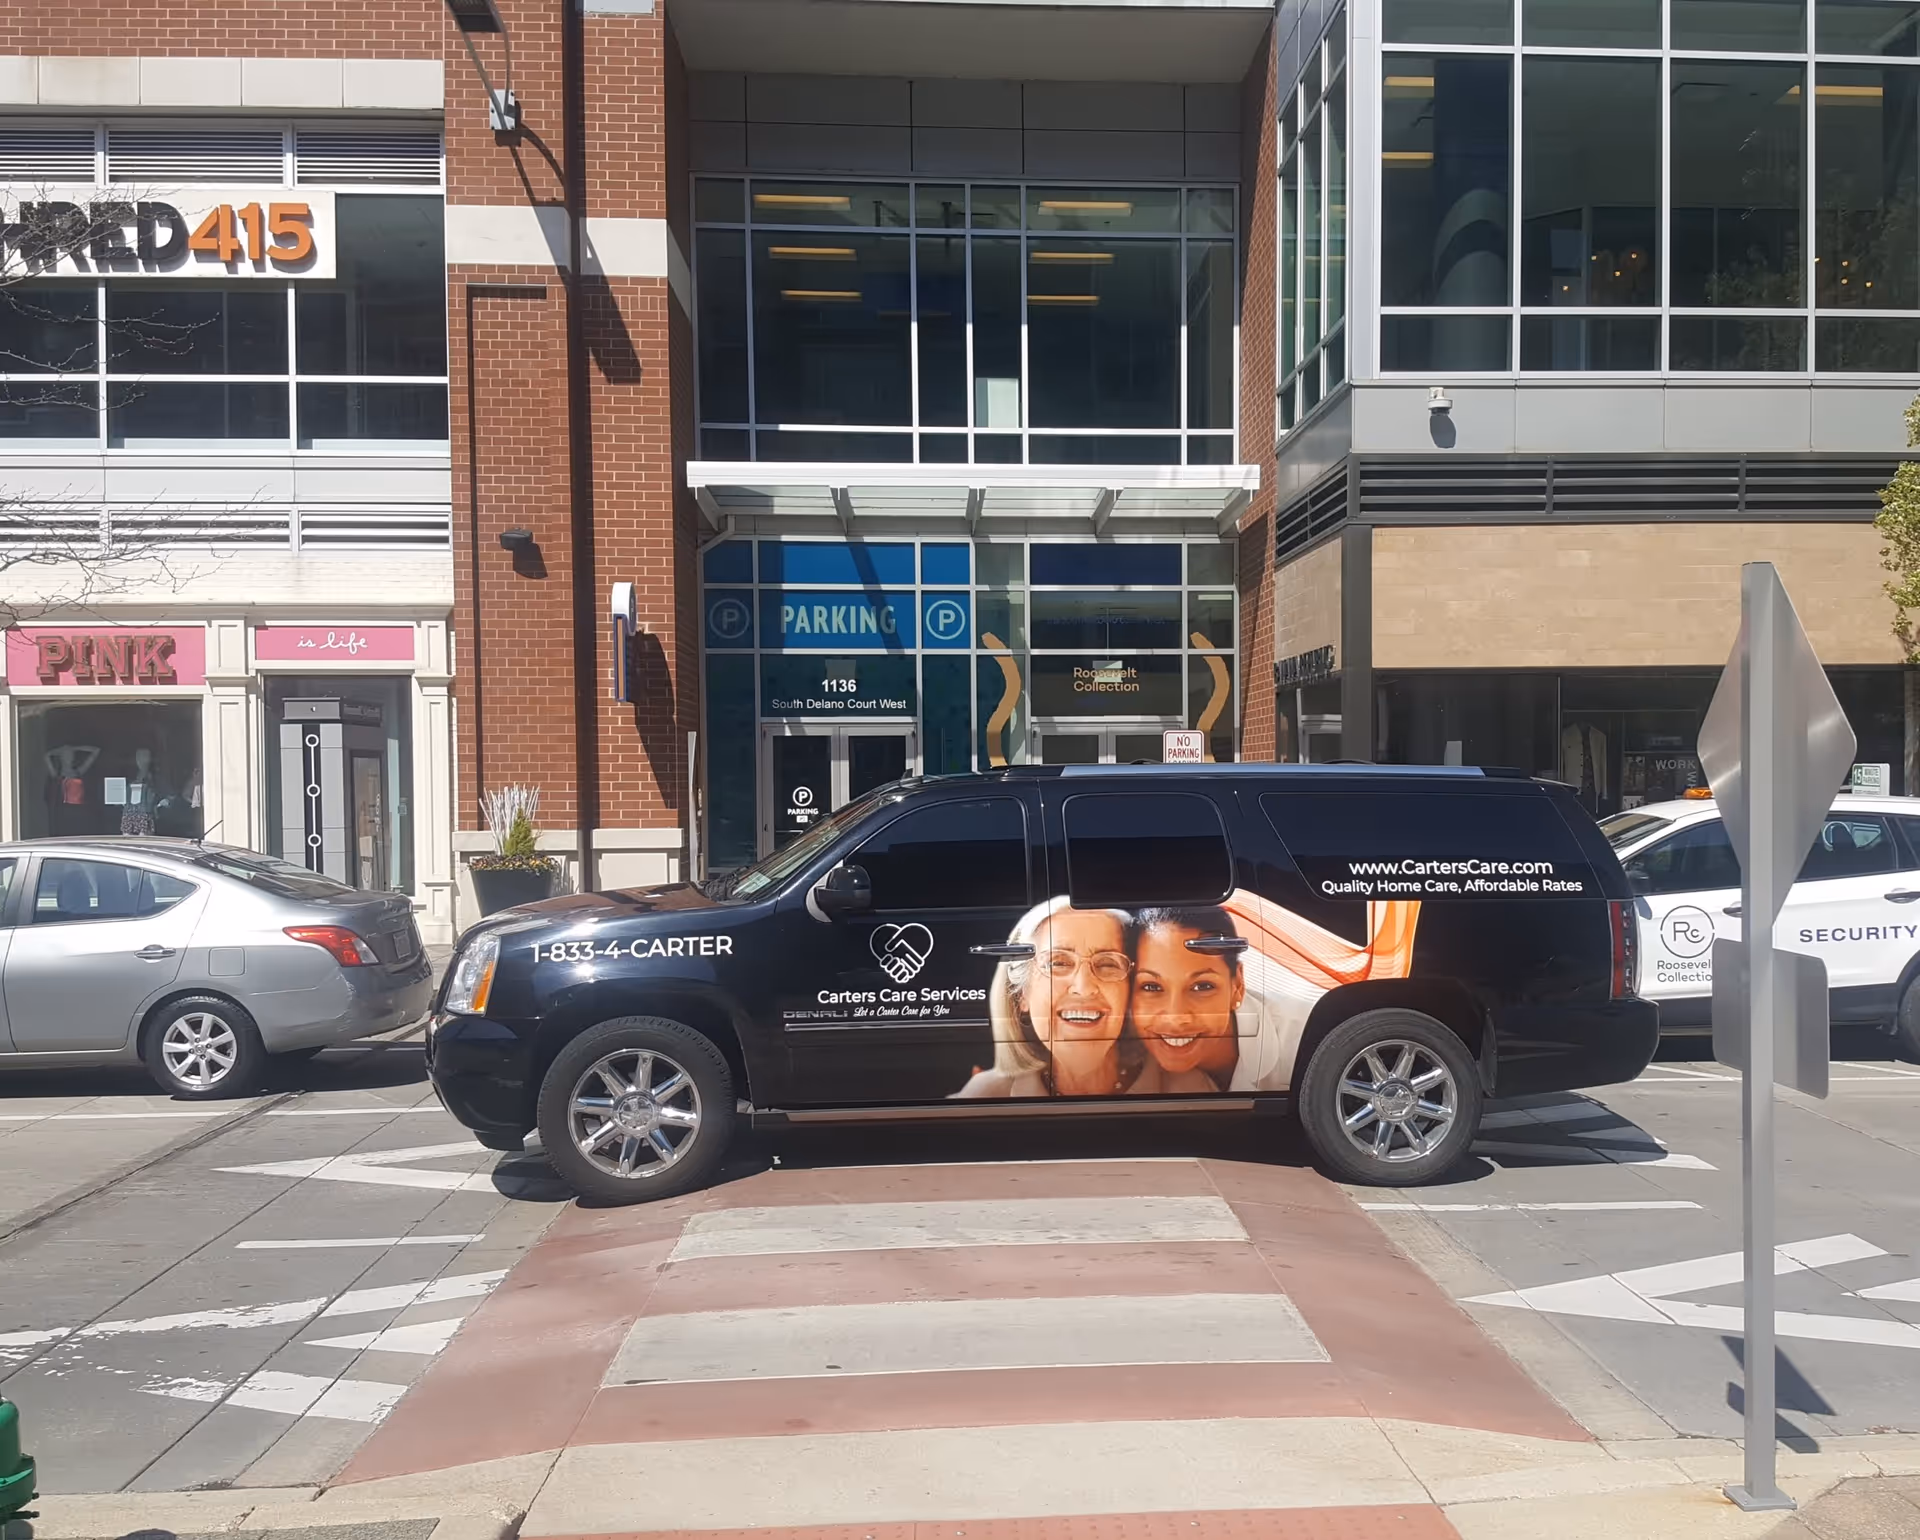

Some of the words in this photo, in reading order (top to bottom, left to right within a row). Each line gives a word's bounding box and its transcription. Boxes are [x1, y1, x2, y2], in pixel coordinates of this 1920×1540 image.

[780, 605, 896, 634] PARKING
[297, 635, 317, 648] is
[319, 631, 368, 655] life
[36, 634, 176, 680] PINK
[1073, 666, 1138, 678] Roosevelt
[821, 679, 857, 693] 1136
[1073, 680, 1140, 692] Collection
[772, 699, 803, 709] South
[806, 699, 844, 709] Delano
[847, 699, 877, 709] Court
[879, 699, 907, 709] West
[1176, 736, 1191, 747] NO
[1167, 748, 1200, 759] PARKING
[1655, 759, 1696, 770] WORK
[1853, 768, 1862, 784] 15
[787, 807, 819, 815] PARKING
[1348, 858, 1554, 875] www.CartersCare.com
[1321, 879, 1374, 895] Quality
[1377, 880, 1422, 892] Home
[1424, 879, 1462, 894] Care,
[1463, 878, 1539, 892] Affordable
[1542, 878, 1583, 892] Rates
[1799, 924, 1918, 943] SECURITY
[530, 935, 734, 963] 1-833-4-CARTER
[1657, 958, 1712, 970] Roosevel
[1657, 971, 1713, 983] Collectio
[817, 989, 876, 1004] Carters
[879, 988, 918, 1003] Care
[920, 986, 987, 1002] Services
[783, 1010, 848, 1019] DENALI
[853, 1006, 869, 1018] Let
[876, 1006, 900, 1018] Carter
[901, 1005, 919, 1017] Care
[919, 1005, 931, 1017] for
[932, 1004, 951, 1017] You
